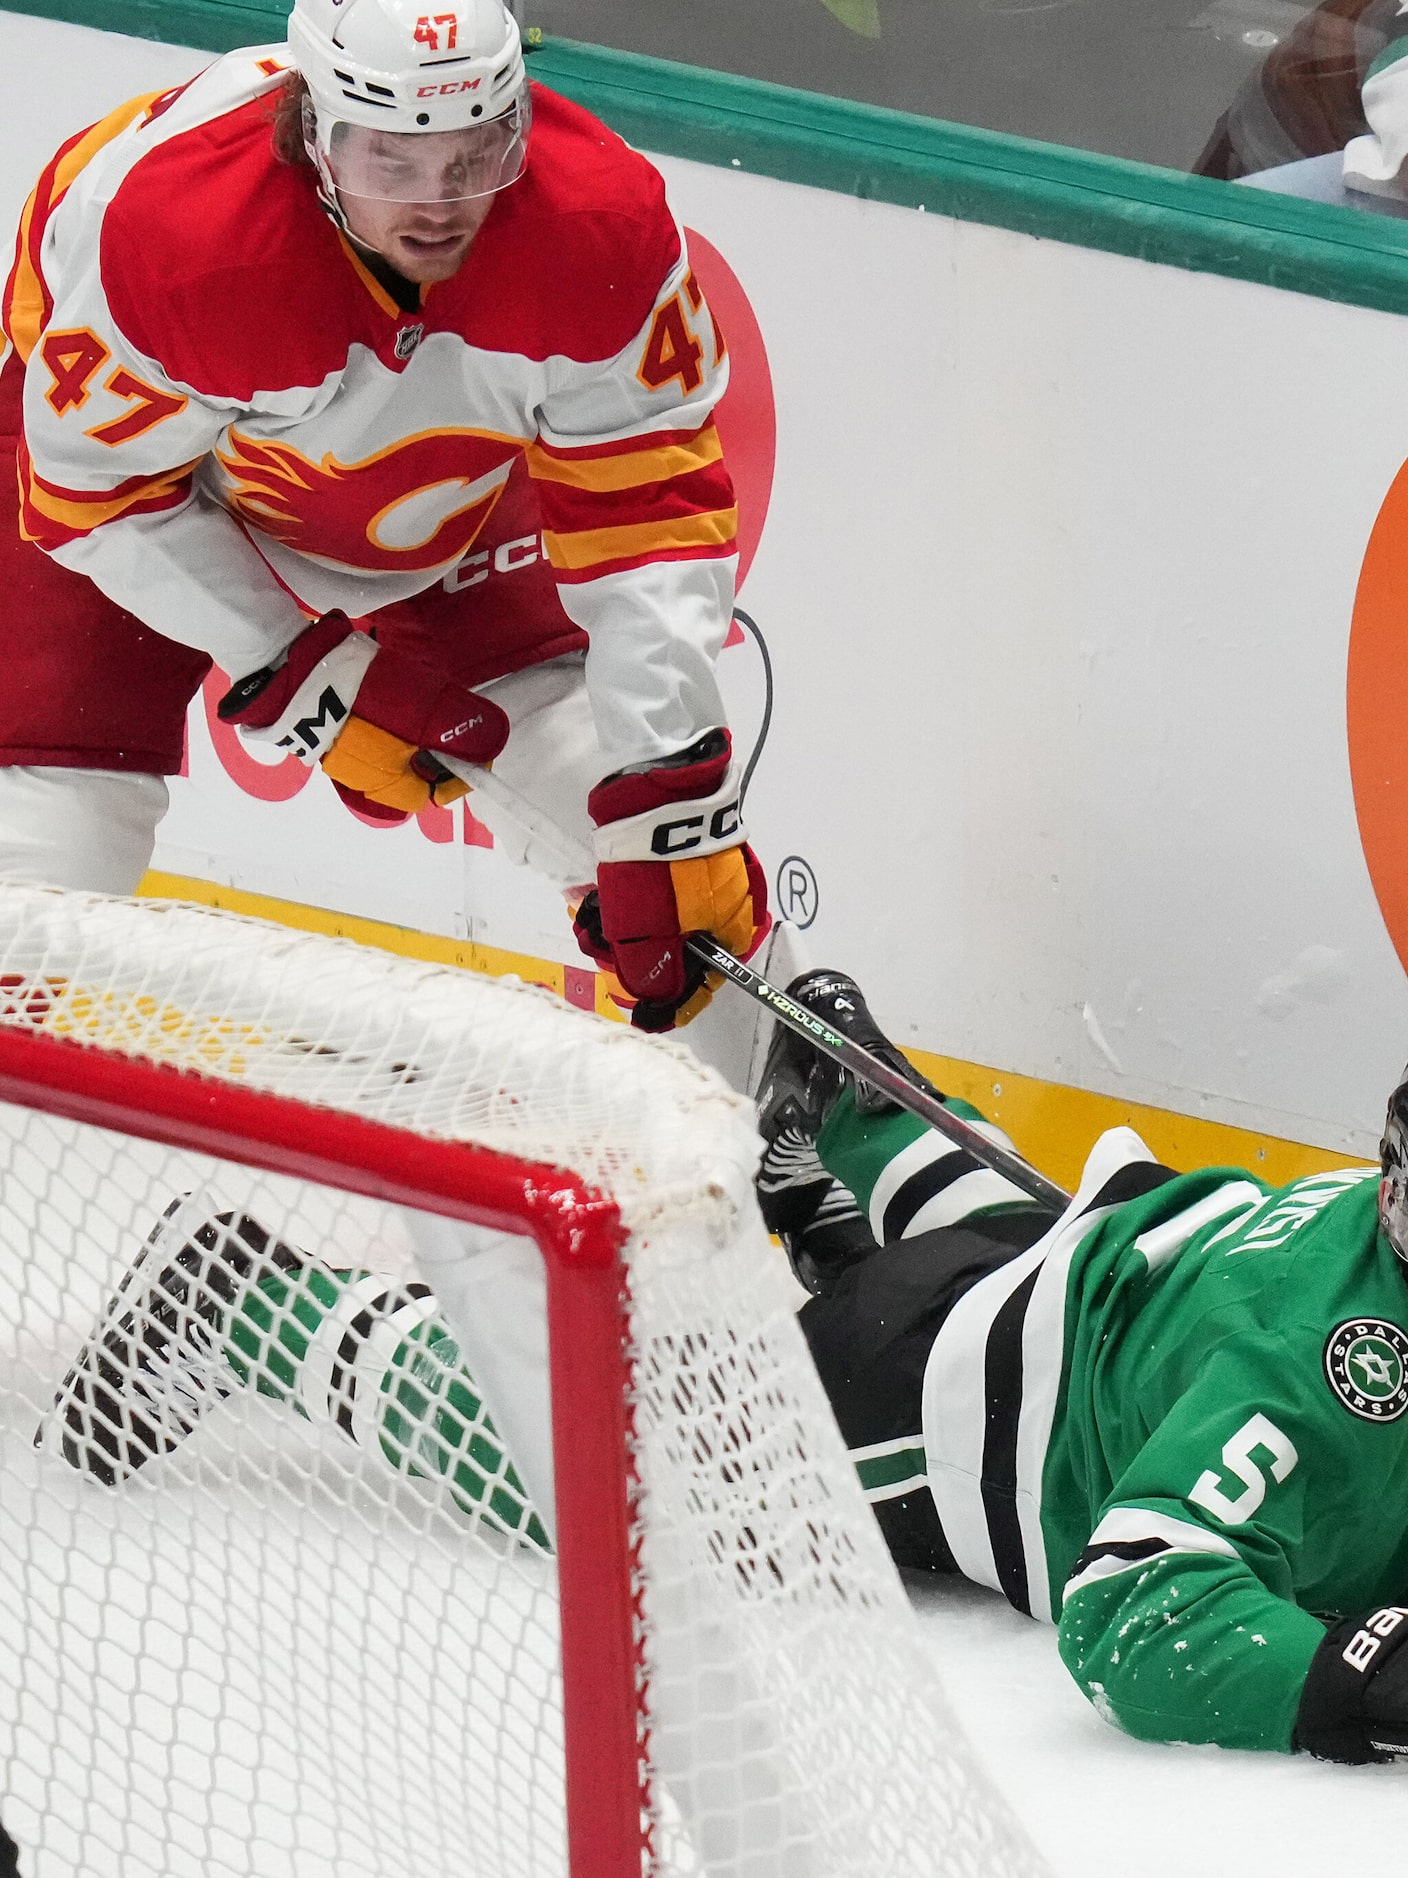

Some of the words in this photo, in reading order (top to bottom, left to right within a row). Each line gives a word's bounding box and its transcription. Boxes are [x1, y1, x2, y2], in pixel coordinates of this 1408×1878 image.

[413, 13, 458, 50] 47
[416, 78, 481, 98] CCM
[40, 326, 189, 448] 47
[443, 533, 551, 594] CC
[440, 713, 483, 743] CCM
[712, 952, 734, 971] ZAR
[767, 991, 825, 1035] HZRDUS
[1334, 1343, 1383, 1414] STARS
[1187, 1412, 1299, 1525] 5
